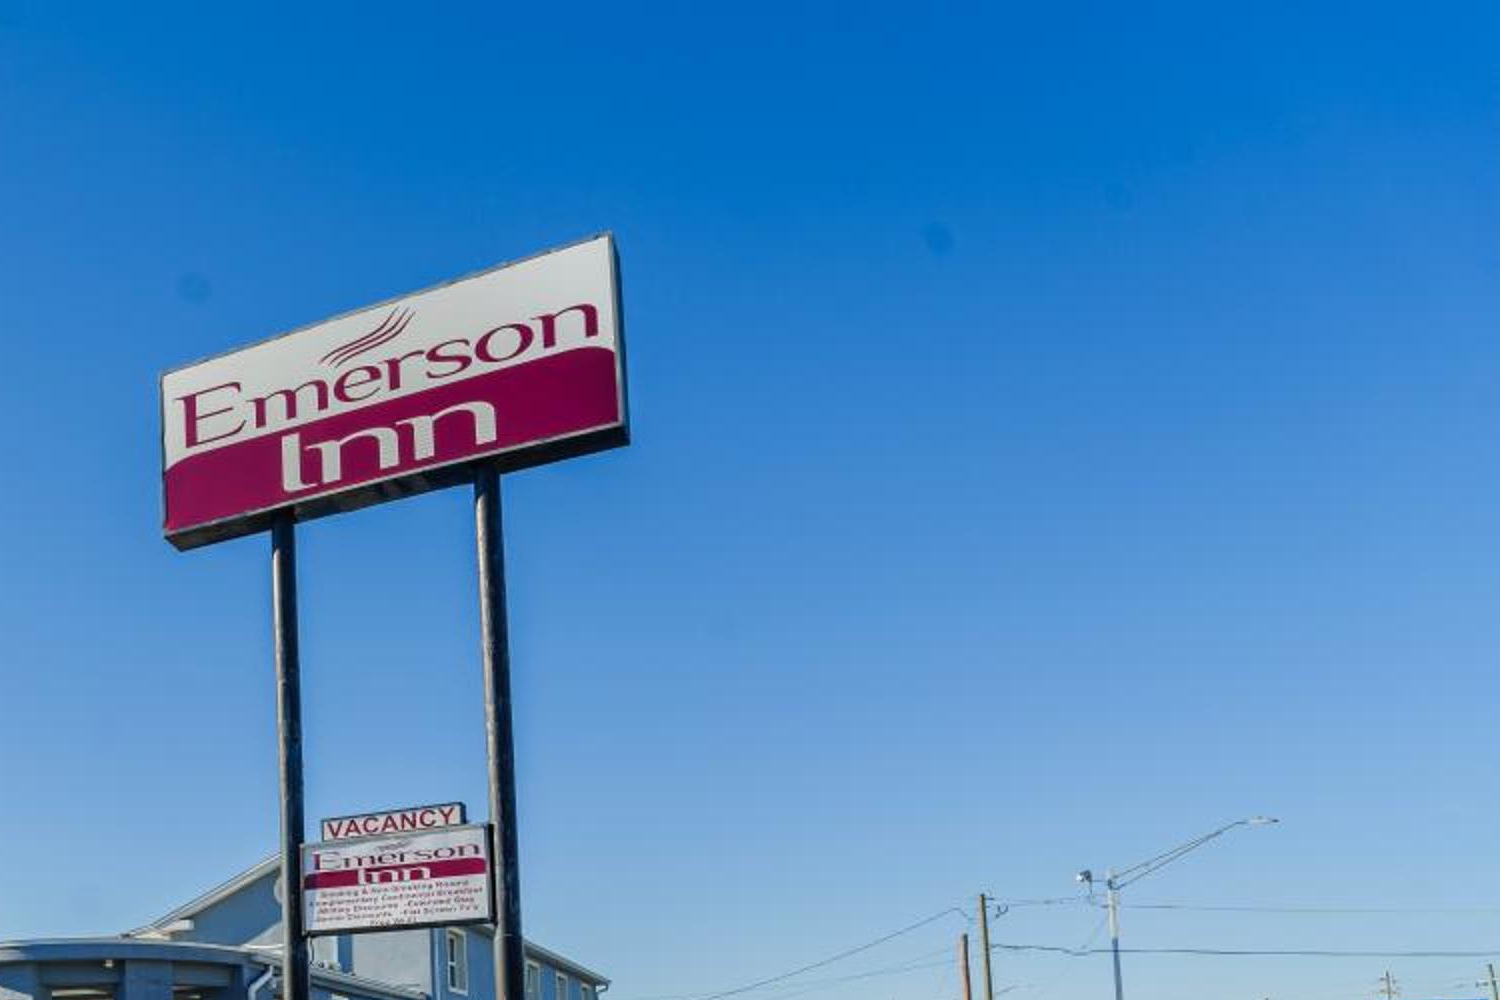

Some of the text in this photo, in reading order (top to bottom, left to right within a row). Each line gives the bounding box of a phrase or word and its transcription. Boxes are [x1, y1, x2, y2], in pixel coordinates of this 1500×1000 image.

[175, 303, 599, 448] Emerson
[281, 400, 497, 492] Inn
[327, 807, 455, 837] VACANCY
[312, 843, 480, 870] Emerson
[357, 866, 432, 885] Inn
